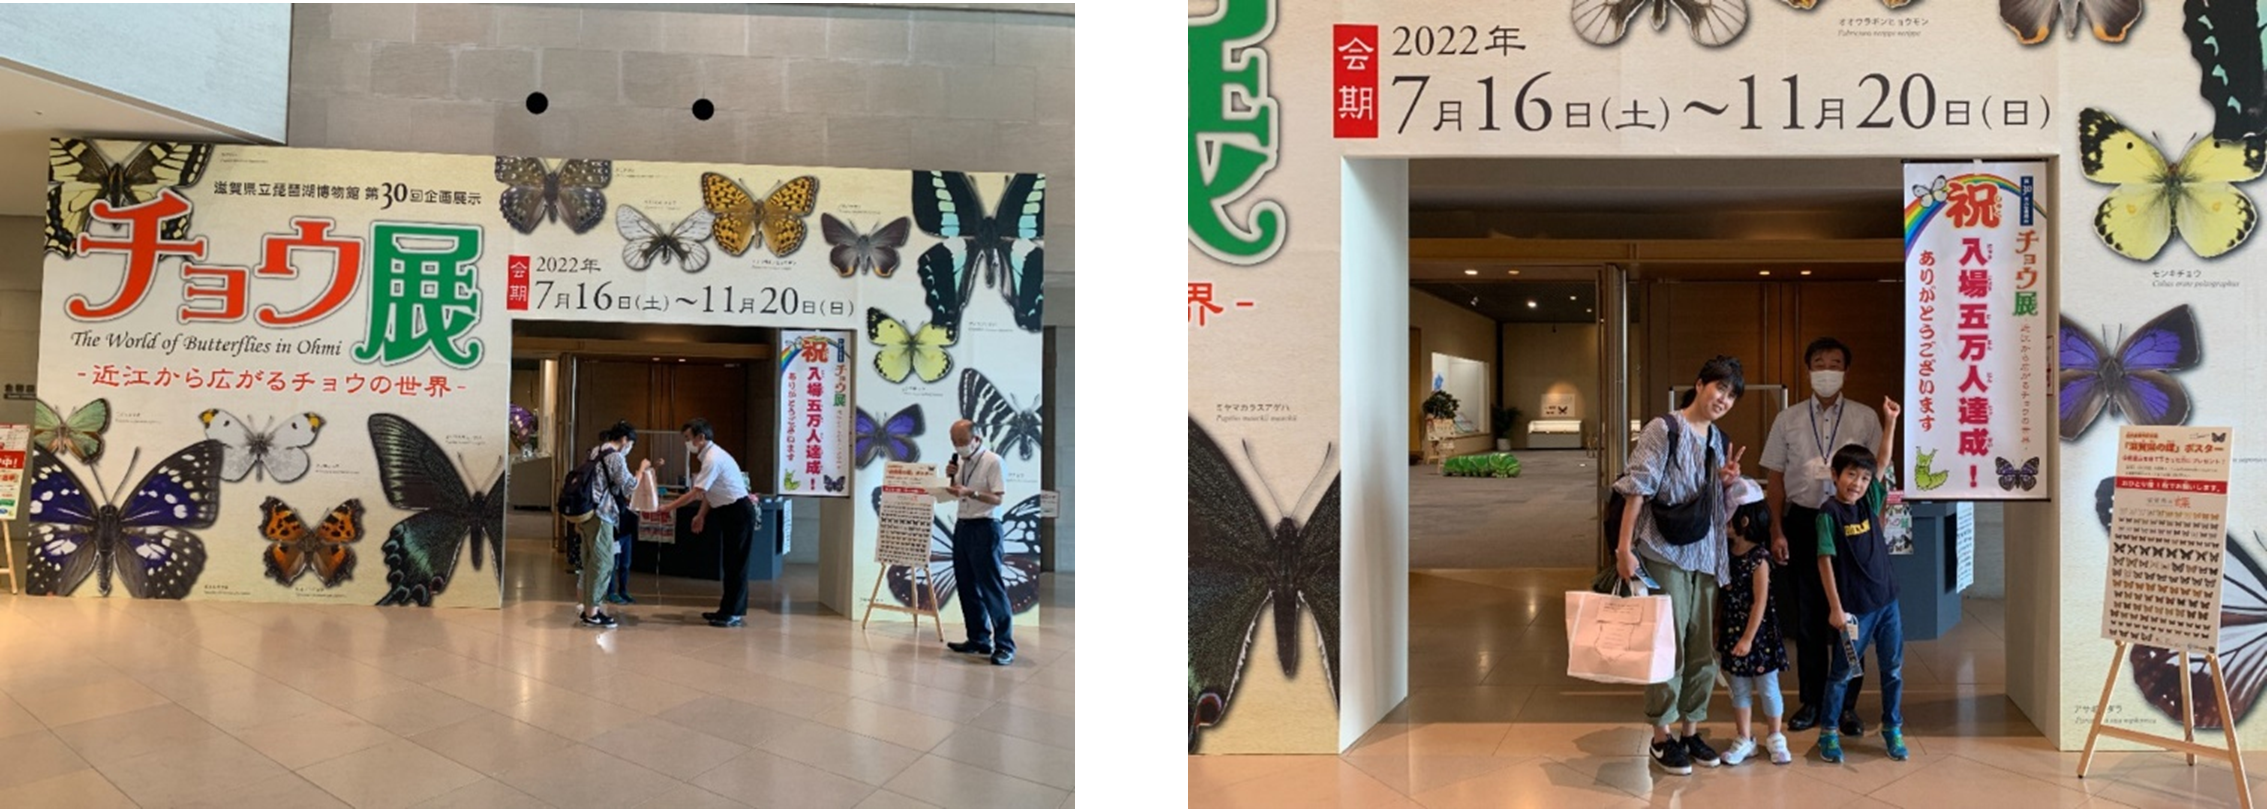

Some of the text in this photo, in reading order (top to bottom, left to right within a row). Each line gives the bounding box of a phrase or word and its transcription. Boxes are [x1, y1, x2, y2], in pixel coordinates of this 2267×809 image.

[1391, 24, 1527, 57] 2022年
[1337, 36, 1374, 121] 会期
[213, 180, 482, 210] 滋賀県立琵琶湖博物館 第30回企画展示
[1946, 181, 2000, 229] 祝
[66, 190, 484, 368] チョウ展
[510, 261, 528, 303] 会期
[535, 256, 602, 274] 2022年
[2012, 230, 2040, 317] チョウ展
[70, 331, 342, 358] The World of Butterflies in Ohmi
[801, 339, 829, 364] 祝
[1918, 250, 1936, 433] ありがとうございます
[1957, 237, 1989, 488] 入場五万人達成!
